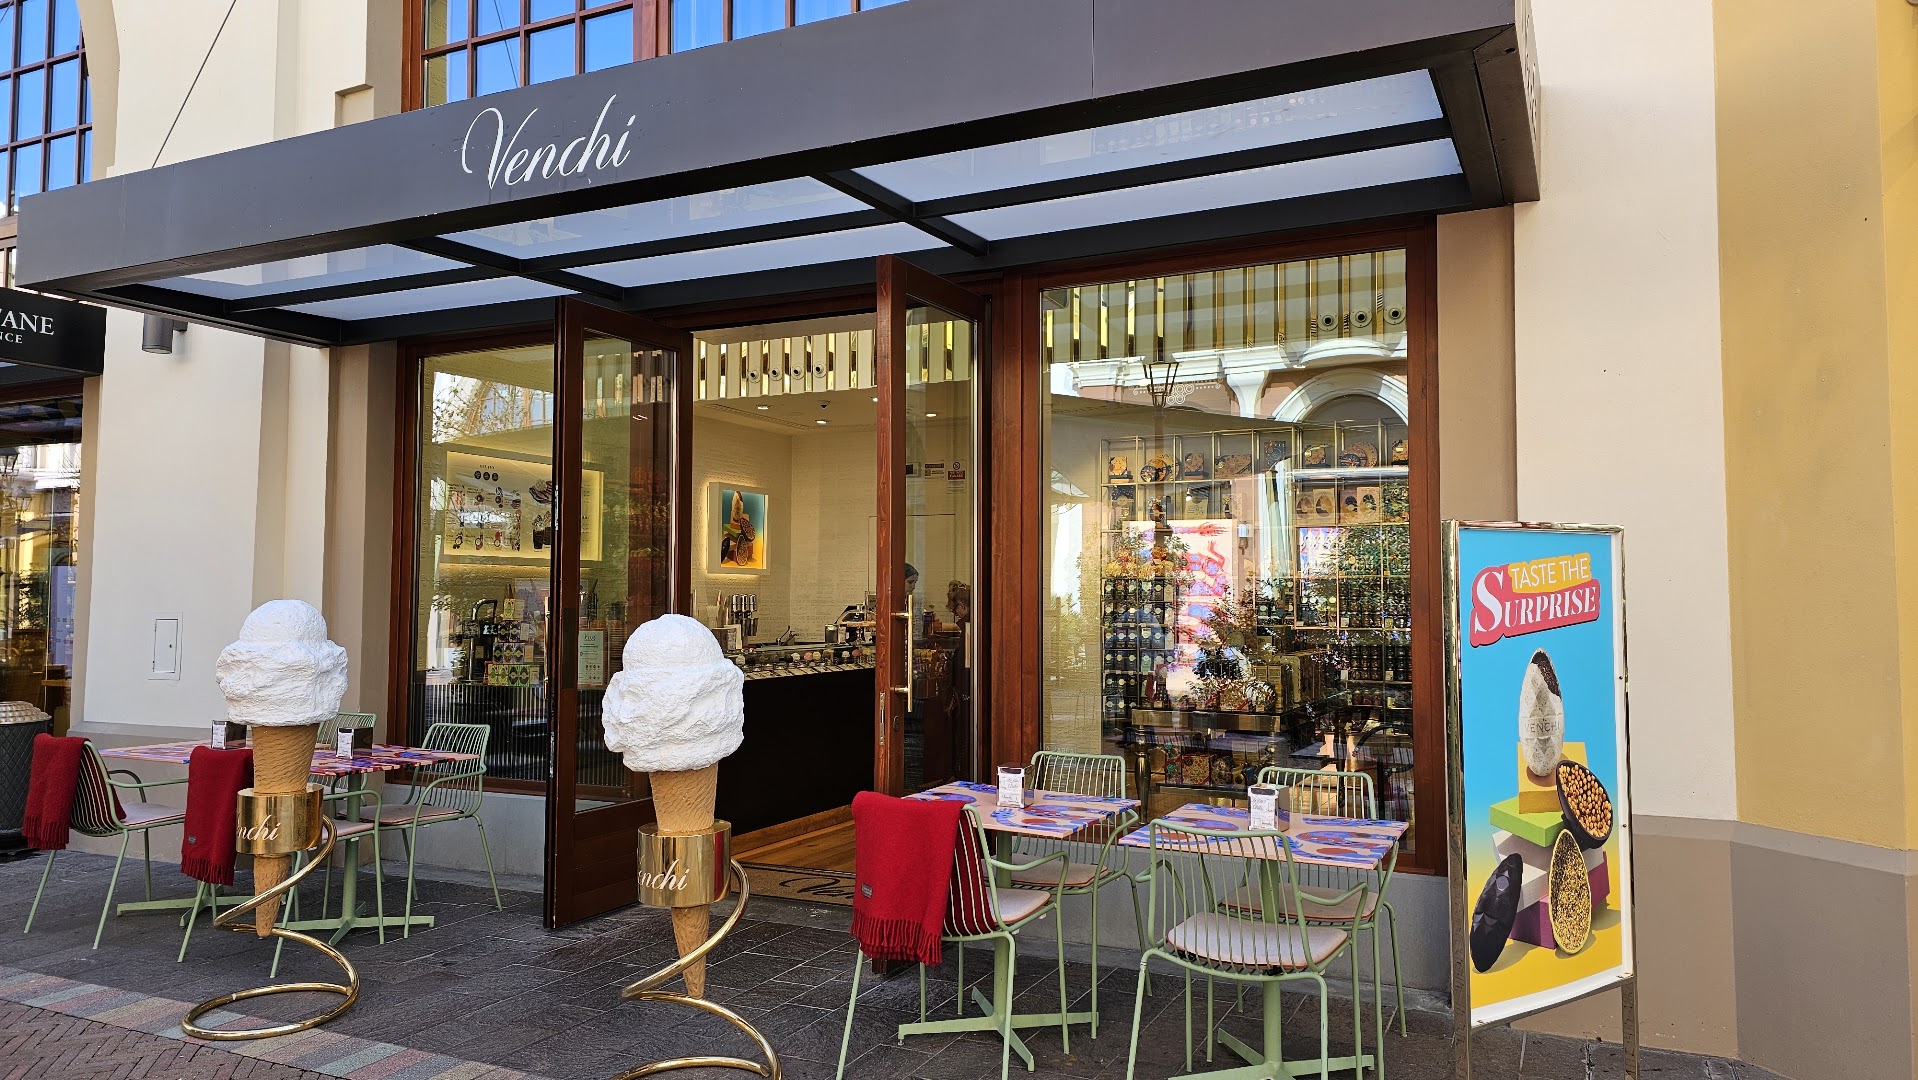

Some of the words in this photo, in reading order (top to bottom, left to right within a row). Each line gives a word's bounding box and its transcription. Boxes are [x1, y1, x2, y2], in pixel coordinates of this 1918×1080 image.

[461, 93, 636, 190] Venchi
[0, 308, 55, 336] ANE
[1510, 562, 1557, 589] TASTE
[1559, 557, 1589, 582] THE
[1474, 570, 1597, 634] SURPRISE
